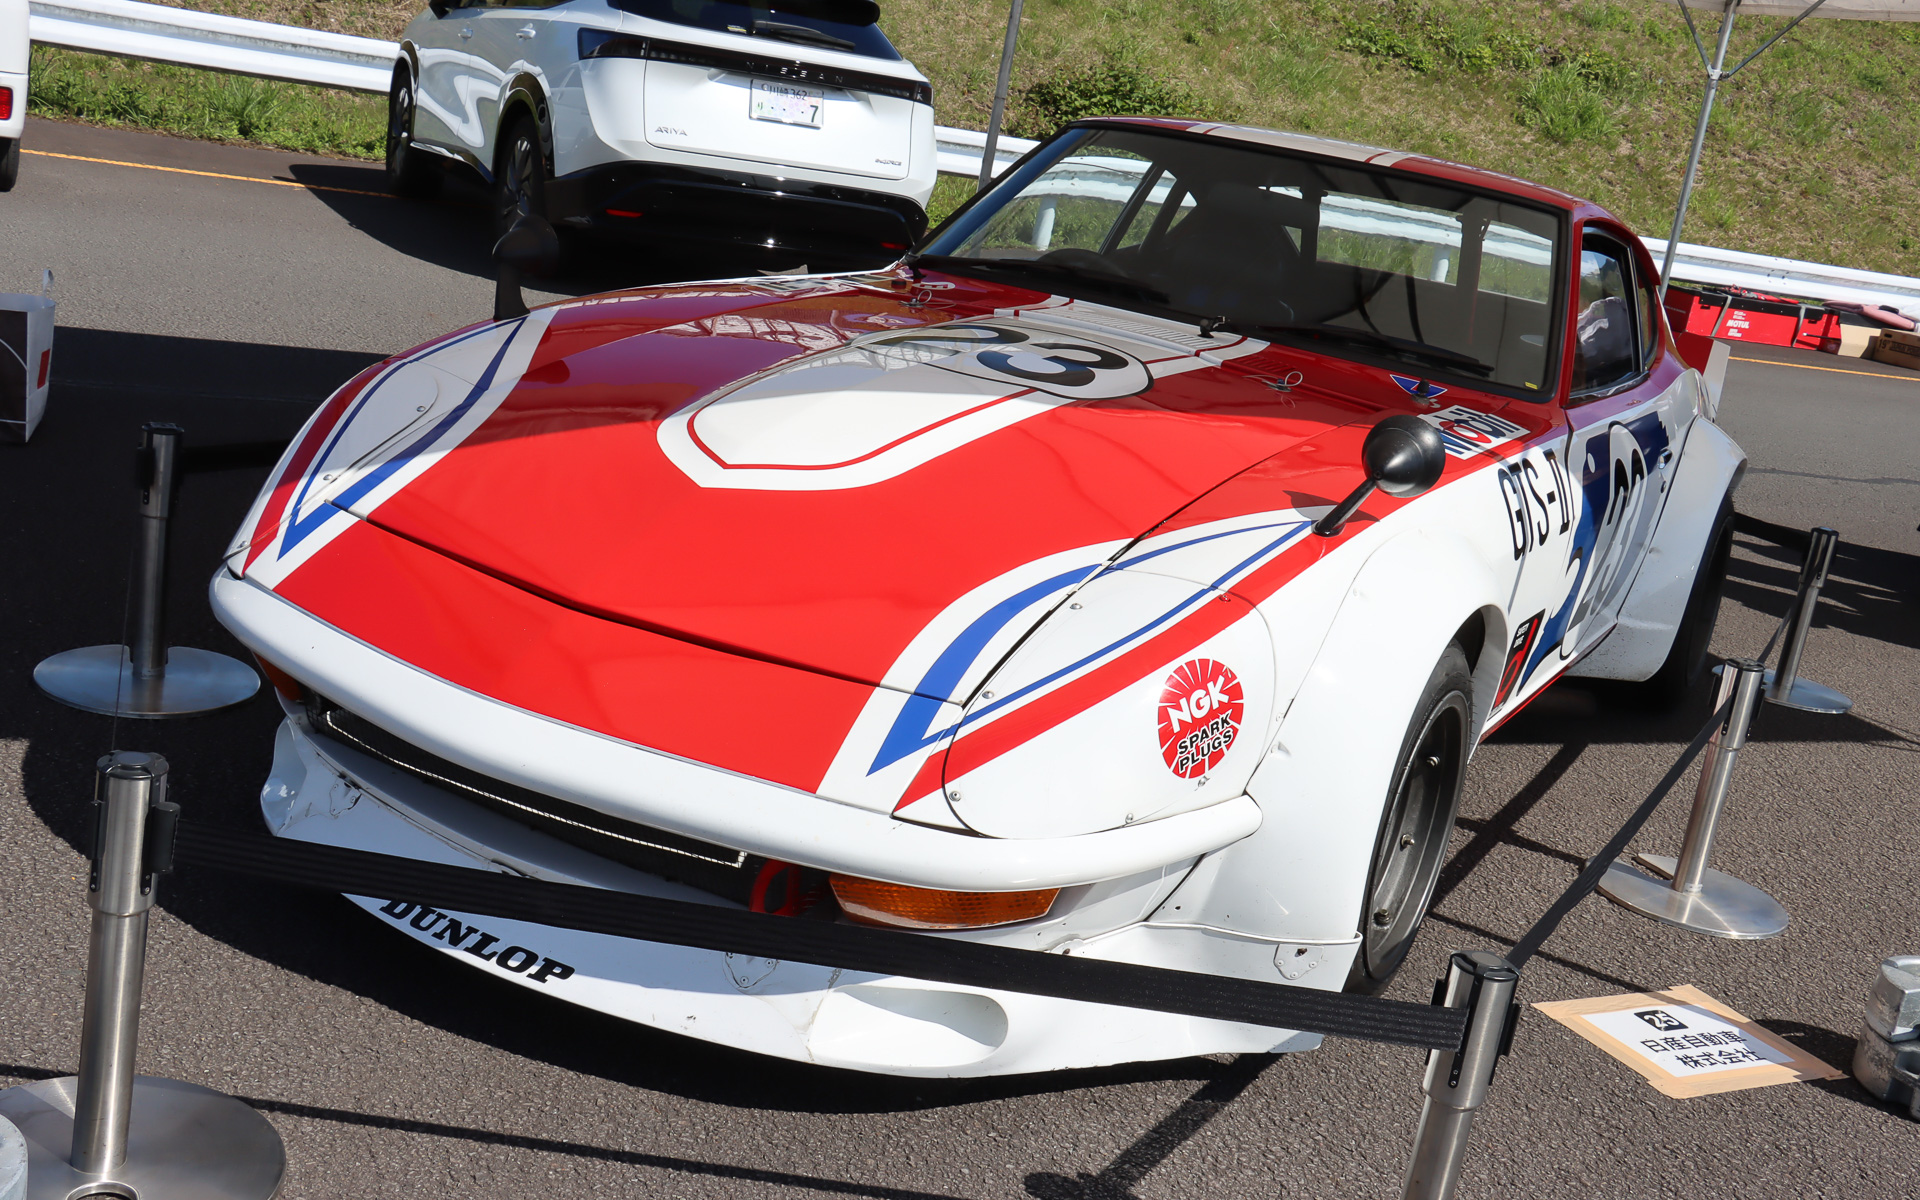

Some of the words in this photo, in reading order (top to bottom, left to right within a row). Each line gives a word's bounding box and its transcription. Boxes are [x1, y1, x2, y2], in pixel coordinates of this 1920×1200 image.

[1726, 319, 1750, 329] MOTUL
[1166, 674, 1230, 734] NGK
[1178, 712, 1232, 755] SPARK
[1179, 729, 1233, 772] PLUGS
[379, 900, 575, 983] DUNLOP
[1643, 1010, 1681, 1029] 25
[1640, 1030, 1748, 1054] 日産自動車
[1675, 1048, 1767, 1070] 株式会社
